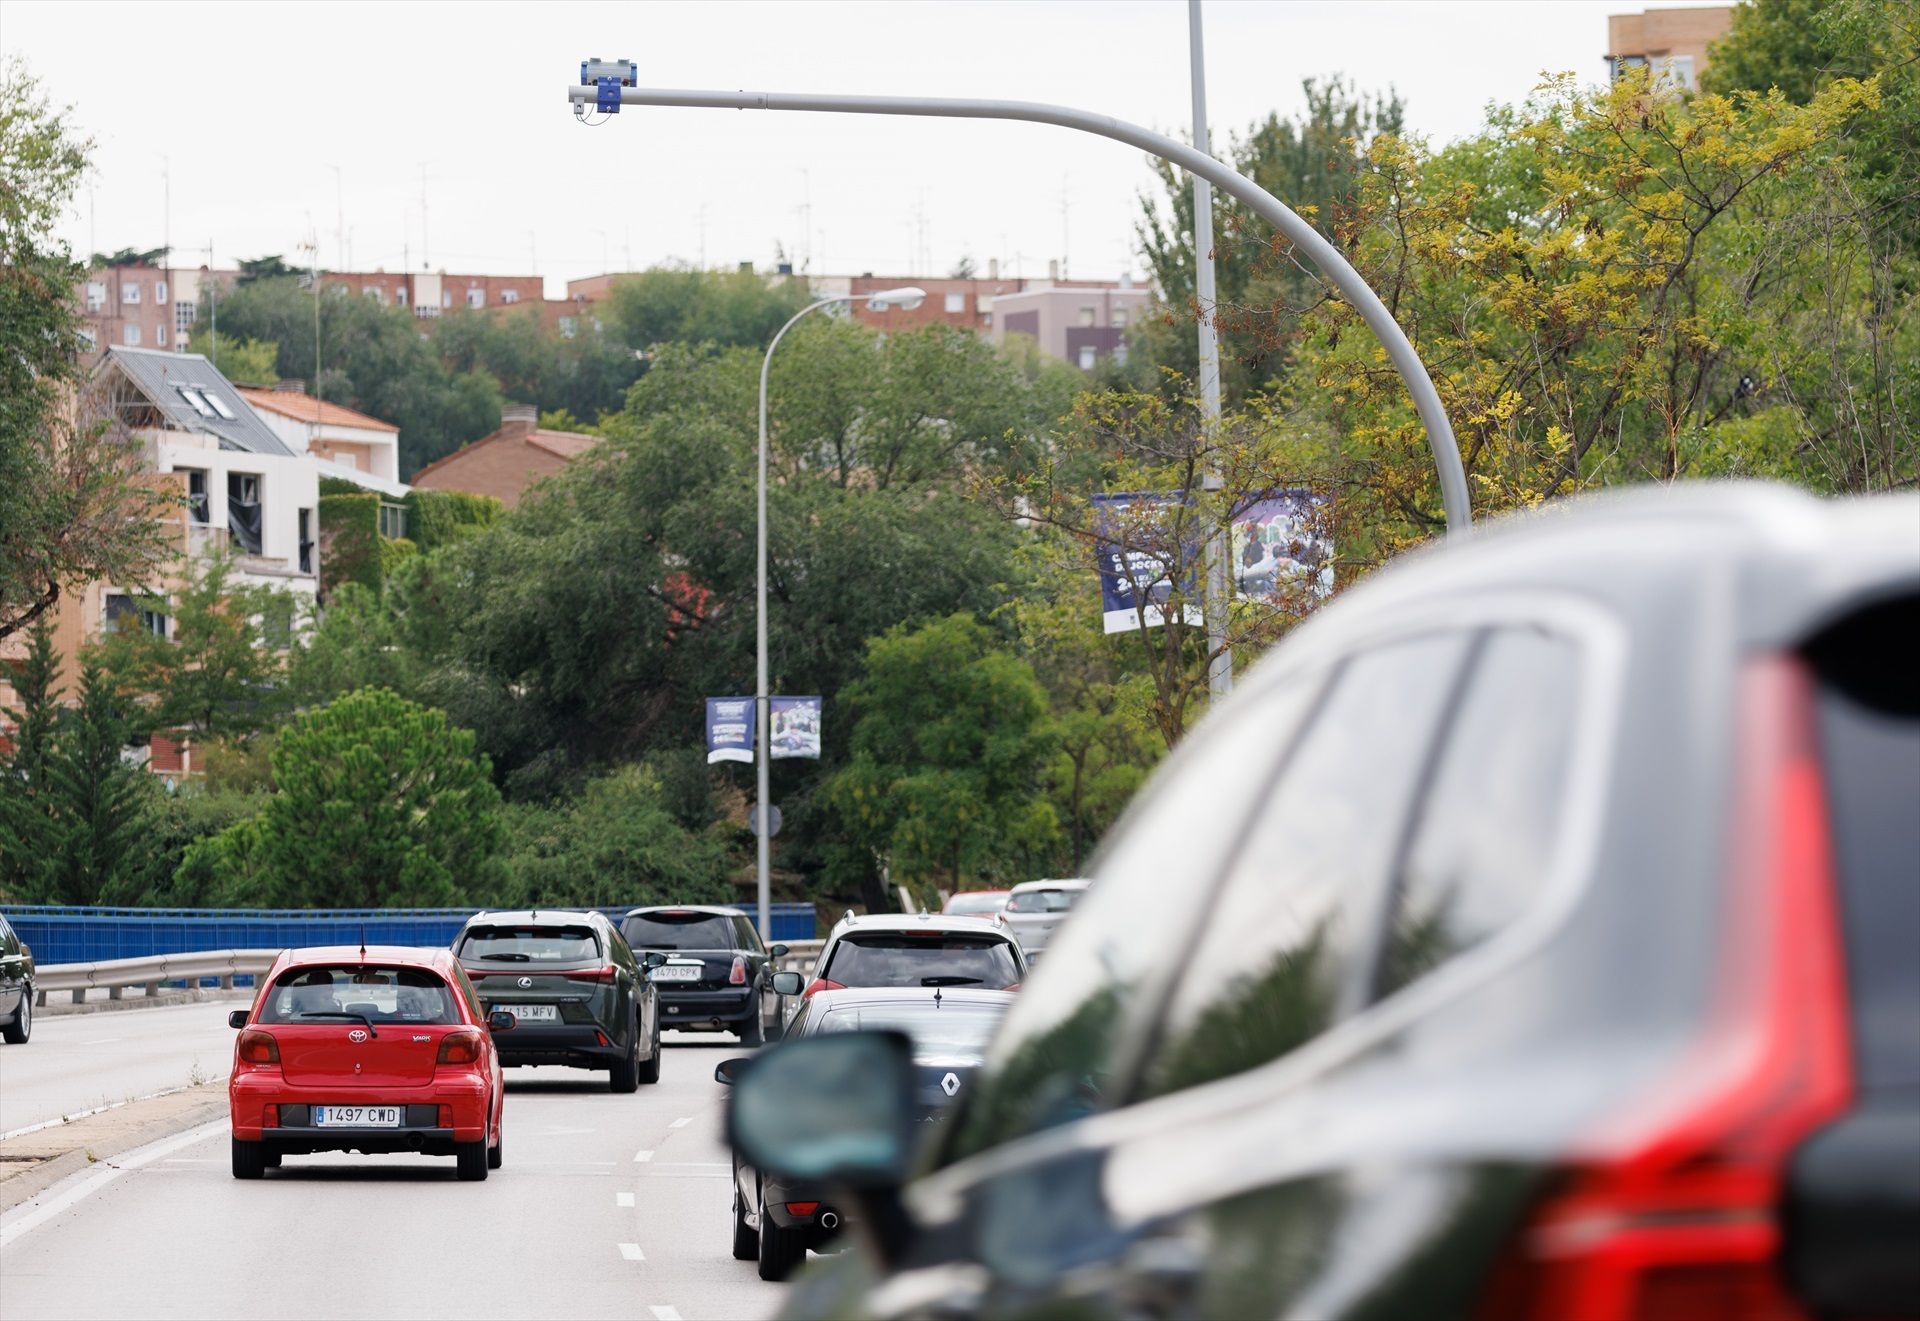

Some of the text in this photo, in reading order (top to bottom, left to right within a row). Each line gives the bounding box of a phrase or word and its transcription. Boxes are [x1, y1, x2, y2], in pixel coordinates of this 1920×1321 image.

[654, 968, 697, 977] 3470 CPK
[532, 1007, 553, 1017] MFV
[328, 1108, 396, 1122] 1497 CWD
